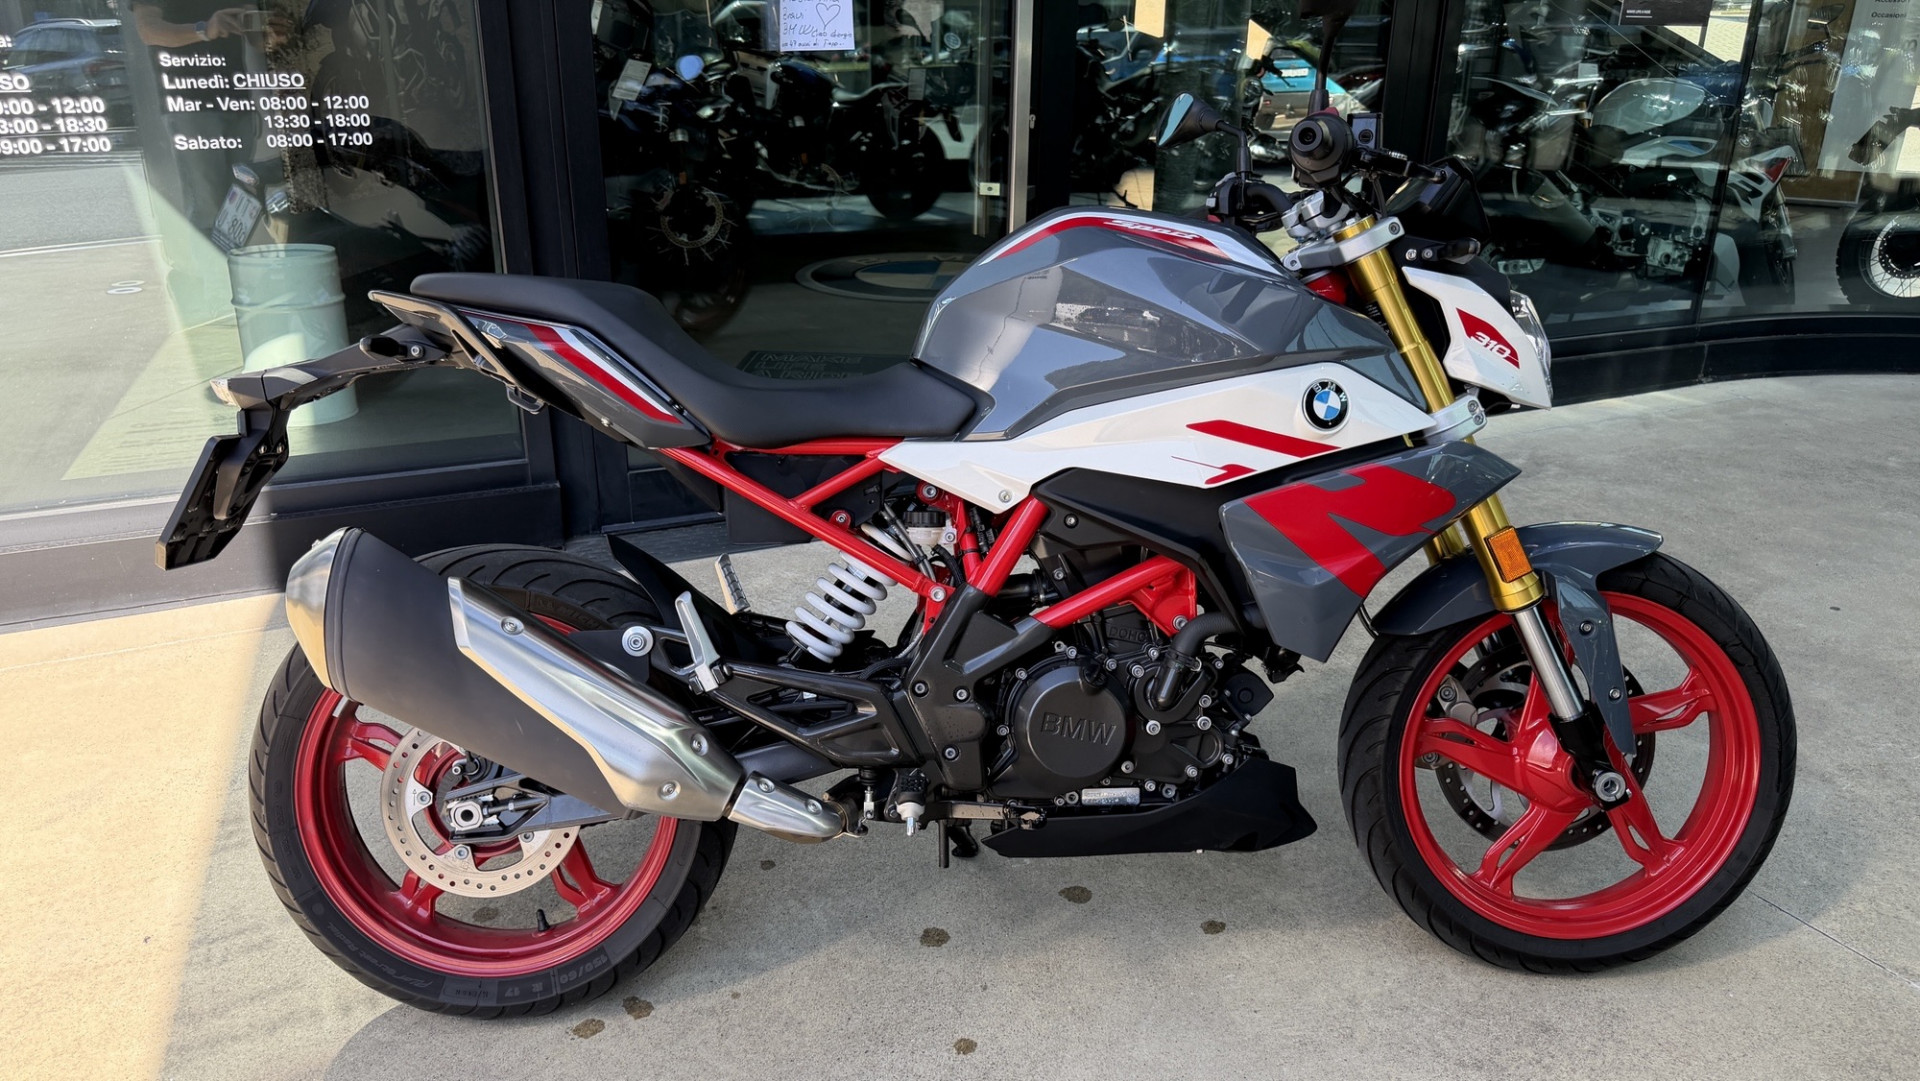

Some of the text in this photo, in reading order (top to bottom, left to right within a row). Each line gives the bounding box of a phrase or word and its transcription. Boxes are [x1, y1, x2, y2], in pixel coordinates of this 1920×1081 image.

[159, 52, 226, 67] Servizio:
[162, 73, 306, 90] Lunedì: CHIUSO
[0, 97, 34, 115] :00
[51, 96, 105, 114] 12:00
[167, 96, 201, 112] Mar
[217, 97, 255, 111] Ven:
[259, 96, 307, 110] 08:00
[323, 95, 369, 109] 12:00
[55, 116, 108, 133] 18:30
[264, 115, 310, 129] 13:30
[326, 113, 370, 127] 18:00
[0, 138, 42, 155] 9:00
[58, 136, 112, 153] 17:00
[174, 134, 242, 150] Sabato:
[266, 134, 313, 148] 08:00
[328, 132, 373, 147] 17:00
[1470, 331, 1511, 359] 310
[1312, 381, 1348, 402] BMW
[1041, 712, 1117, 746] BMW
